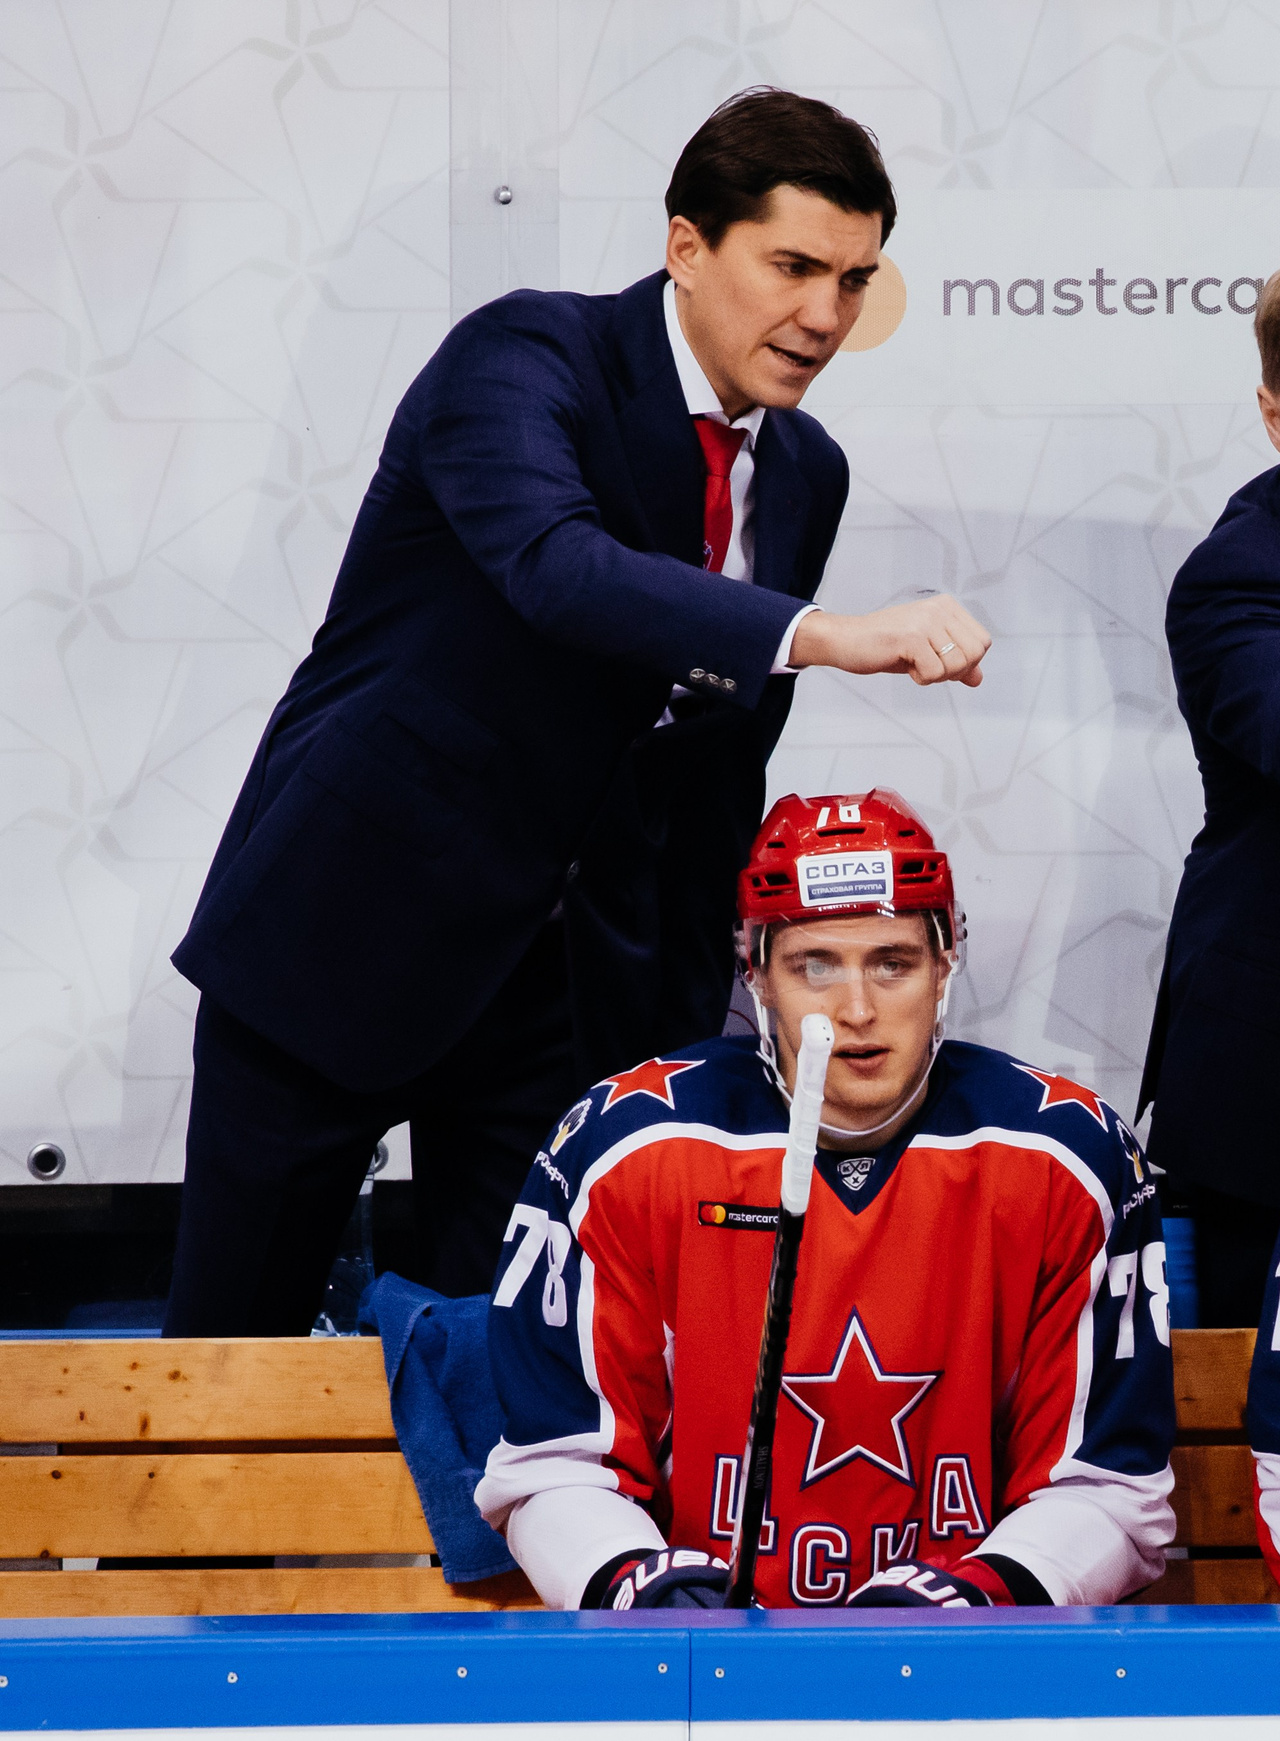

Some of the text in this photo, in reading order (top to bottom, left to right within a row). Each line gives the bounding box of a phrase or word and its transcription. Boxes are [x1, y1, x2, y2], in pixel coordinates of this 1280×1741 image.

[942, 267, 1264, 316] masterca
[806, 862, 885, 879] СОГАЗ
[493, 1203, 572, 1328] 78
[1107, 1242, 1171, 1360] 78
